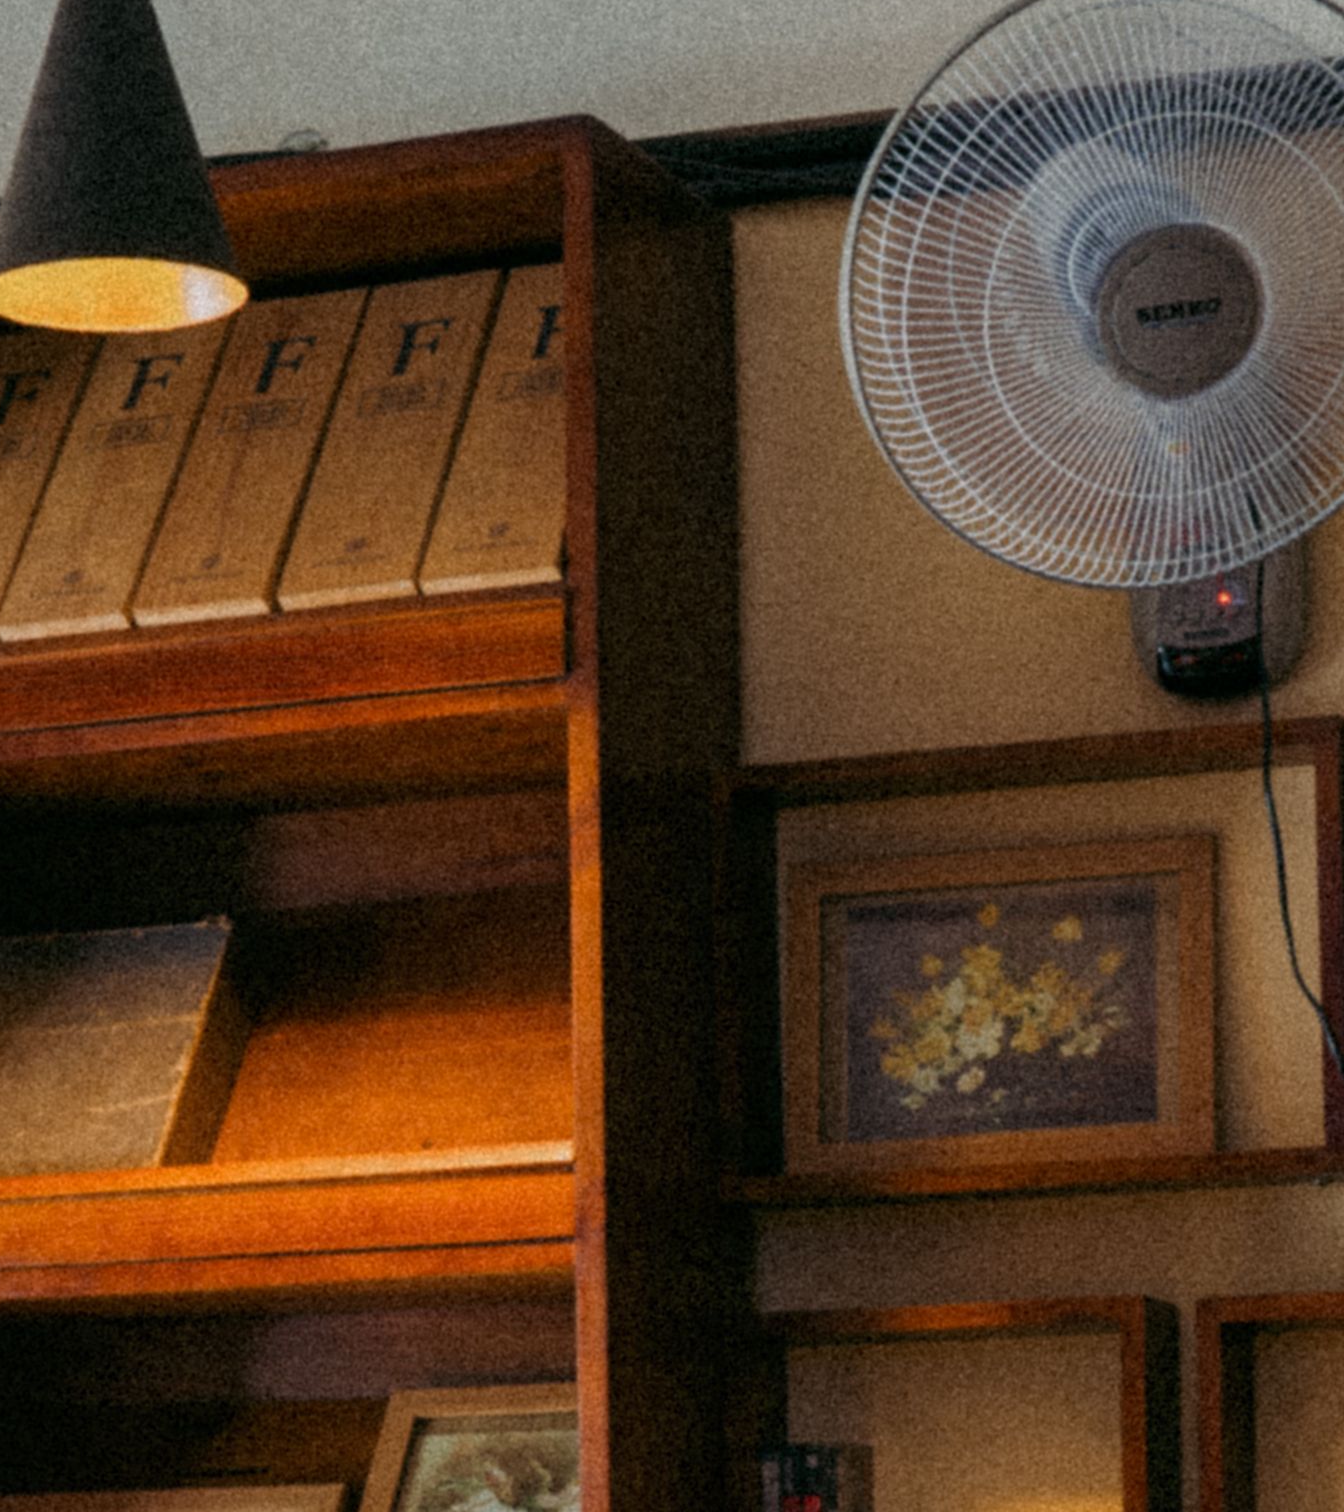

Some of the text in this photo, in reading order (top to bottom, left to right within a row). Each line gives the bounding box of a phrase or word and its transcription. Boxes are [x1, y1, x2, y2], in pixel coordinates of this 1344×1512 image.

[255, 334, 318, 395] F
[391, 317, 454, 377] F
[123, 353, 185, 411] F
